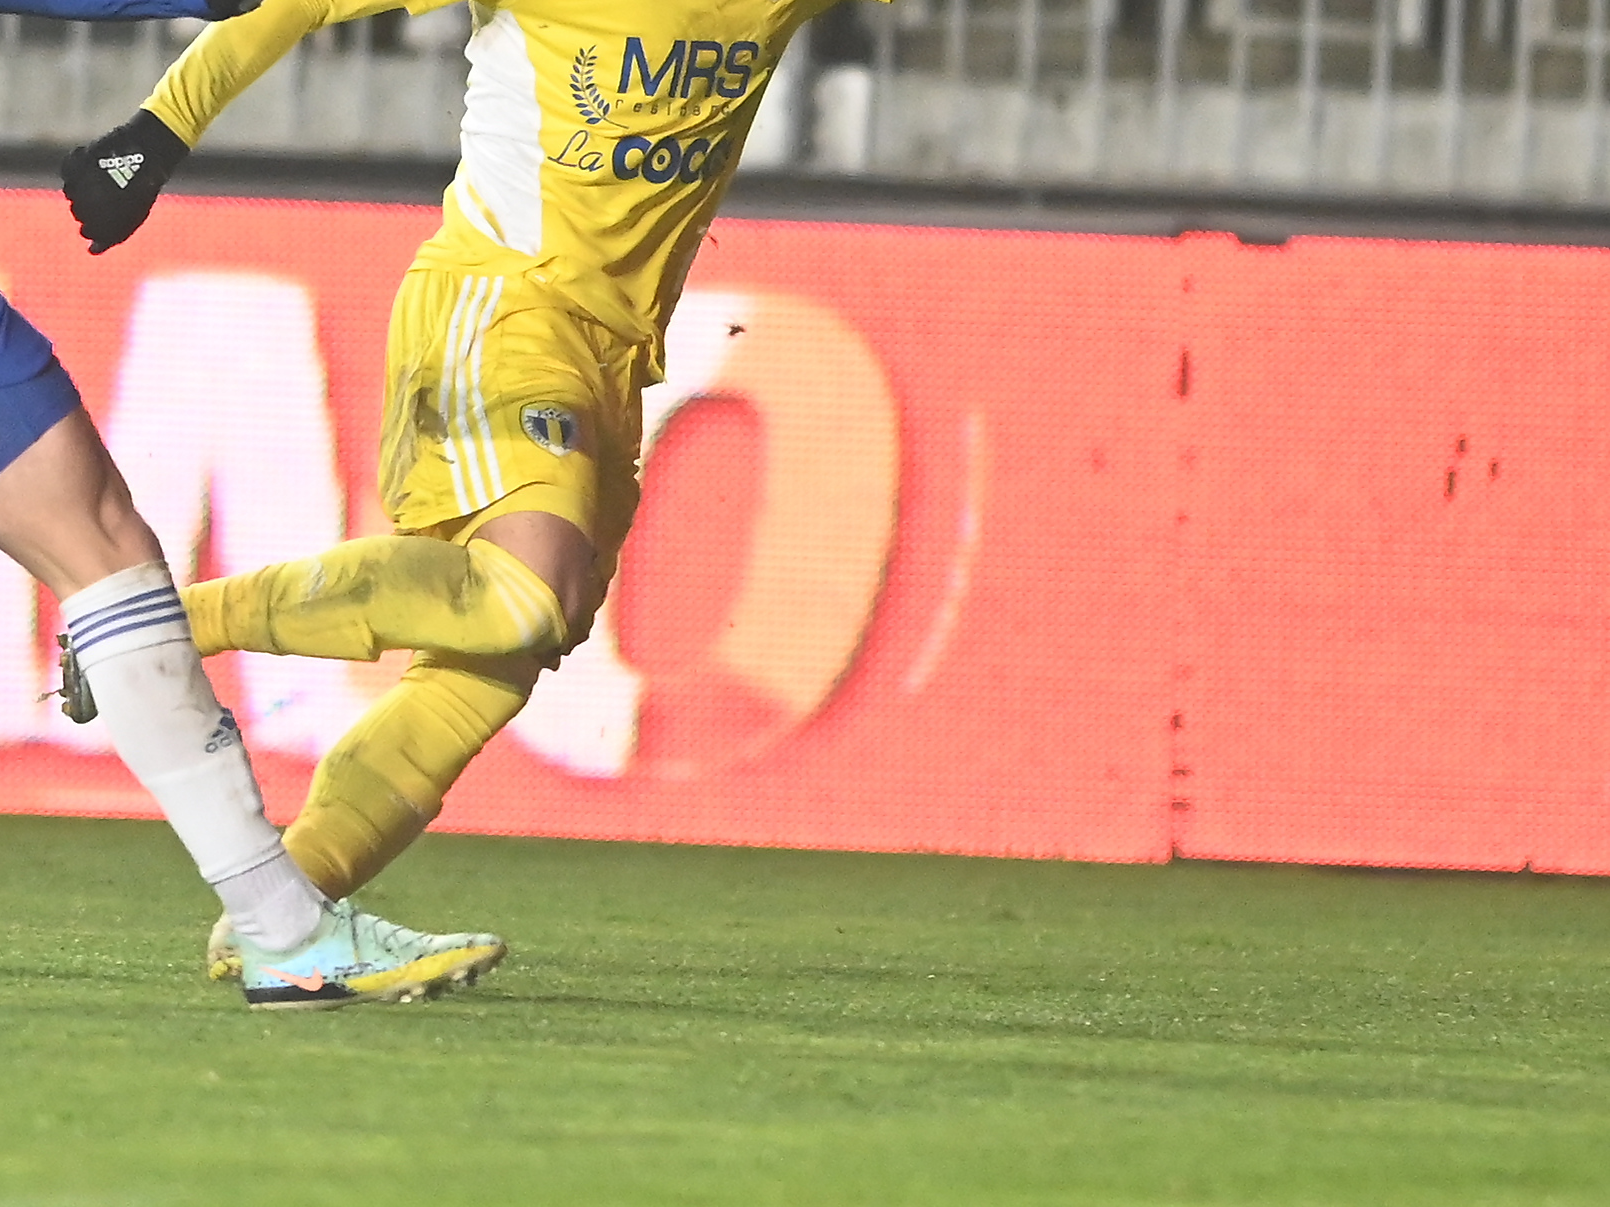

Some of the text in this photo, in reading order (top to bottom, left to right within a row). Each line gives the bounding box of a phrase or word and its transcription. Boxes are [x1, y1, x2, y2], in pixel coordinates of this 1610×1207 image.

[617, 36, 759, 99] MRS
[98, 153, 144, 169] adidas
[547, 130, 605, 172] La
